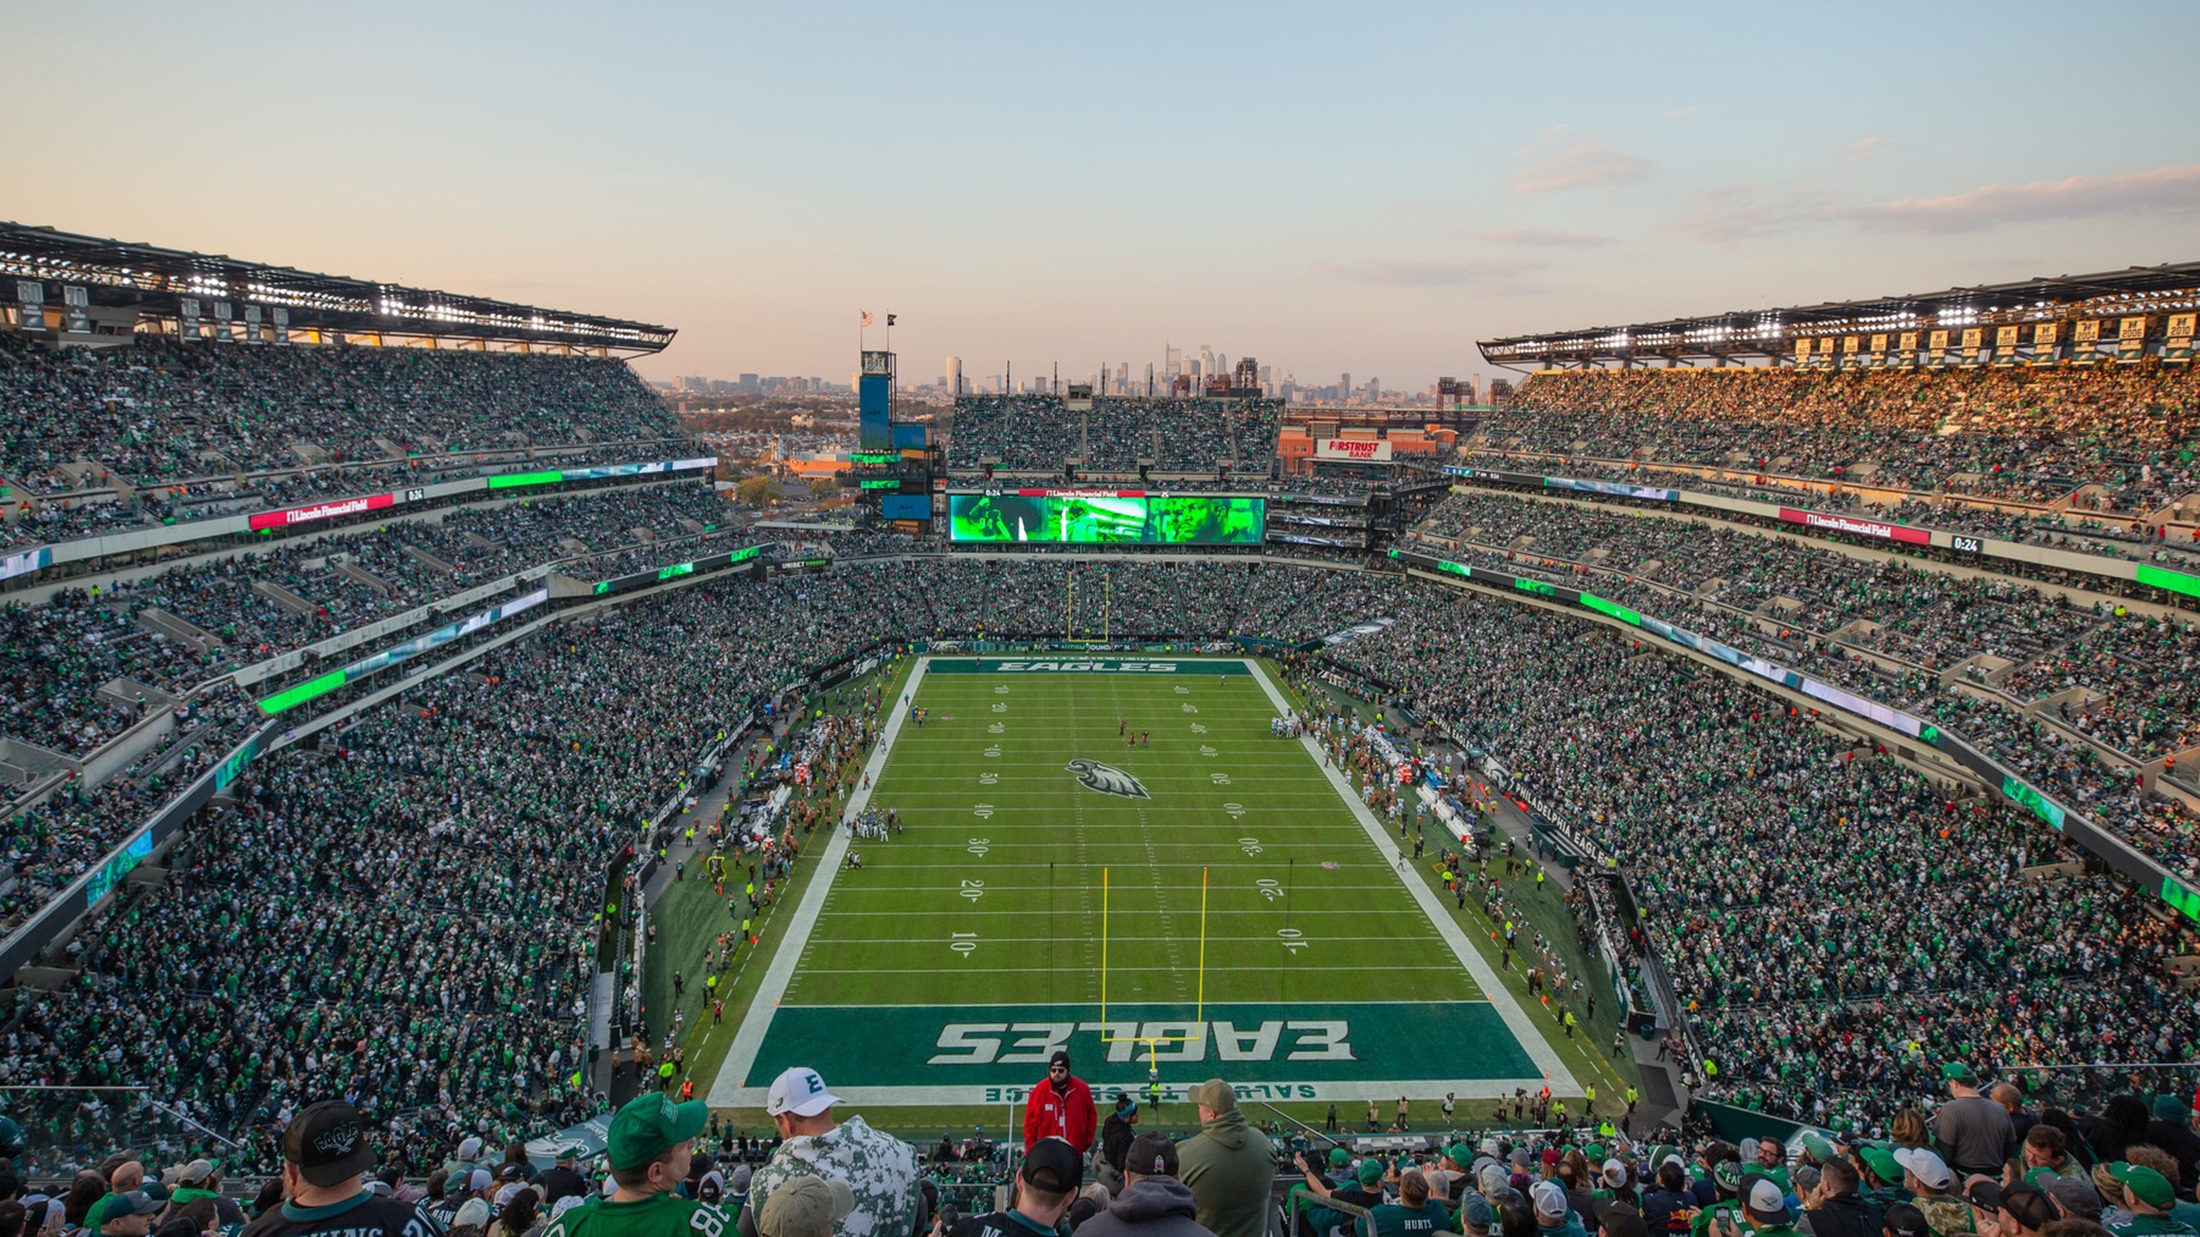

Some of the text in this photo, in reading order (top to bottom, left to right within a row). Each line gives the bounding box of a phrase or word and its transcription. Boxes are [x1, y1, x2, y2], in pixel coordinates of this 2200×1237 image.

[2077, 331, 2096, 340] 2004
[2122, 329, 2142, 338] 2006
[2170, 326, 2191, 336] 2010
[985, 489, 1001, 497] 0:24
[294, 499, 369, 522] Lincoln Financial Field
[1814, 514, 1892, 538] Lincoln Financial Field
[1954, 538, 1979, 552] 0:24
[782, 561, 805, 569] UNIBET
[997, 662, 1177, 672] EAGLES
[1515, 782, 1571, 838] PHILADELPHIA
[926, 1020, 1357, 1065] EAGLES
[805, 1074, 823, 1094] E
[1404, 1219, 1432, 1230] HURTS
